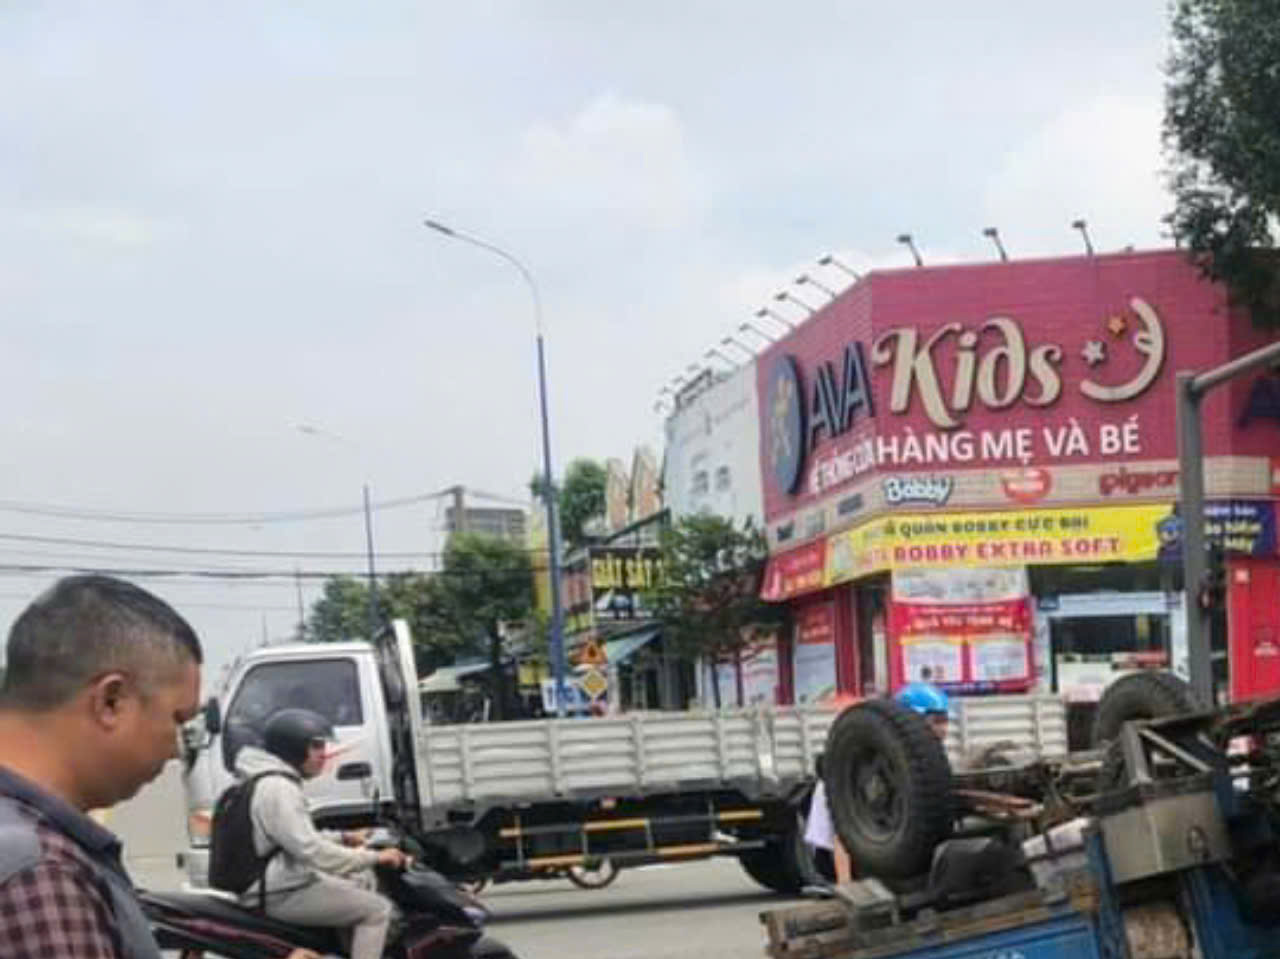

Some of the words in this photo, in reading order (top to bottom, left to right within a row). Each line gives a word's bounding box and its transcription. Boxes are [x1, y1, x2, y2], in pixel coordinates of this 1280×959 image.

[807, 342, 874, 446] AVA
[873, 316, 1062, 428] Kids
[876, 428, 972, 465] HÀNG
[982, 428, 1034, 466] MẸ
[1043, 416, 1089, 457] VÀ
[1099, 414, 1142, 454] BÉ
